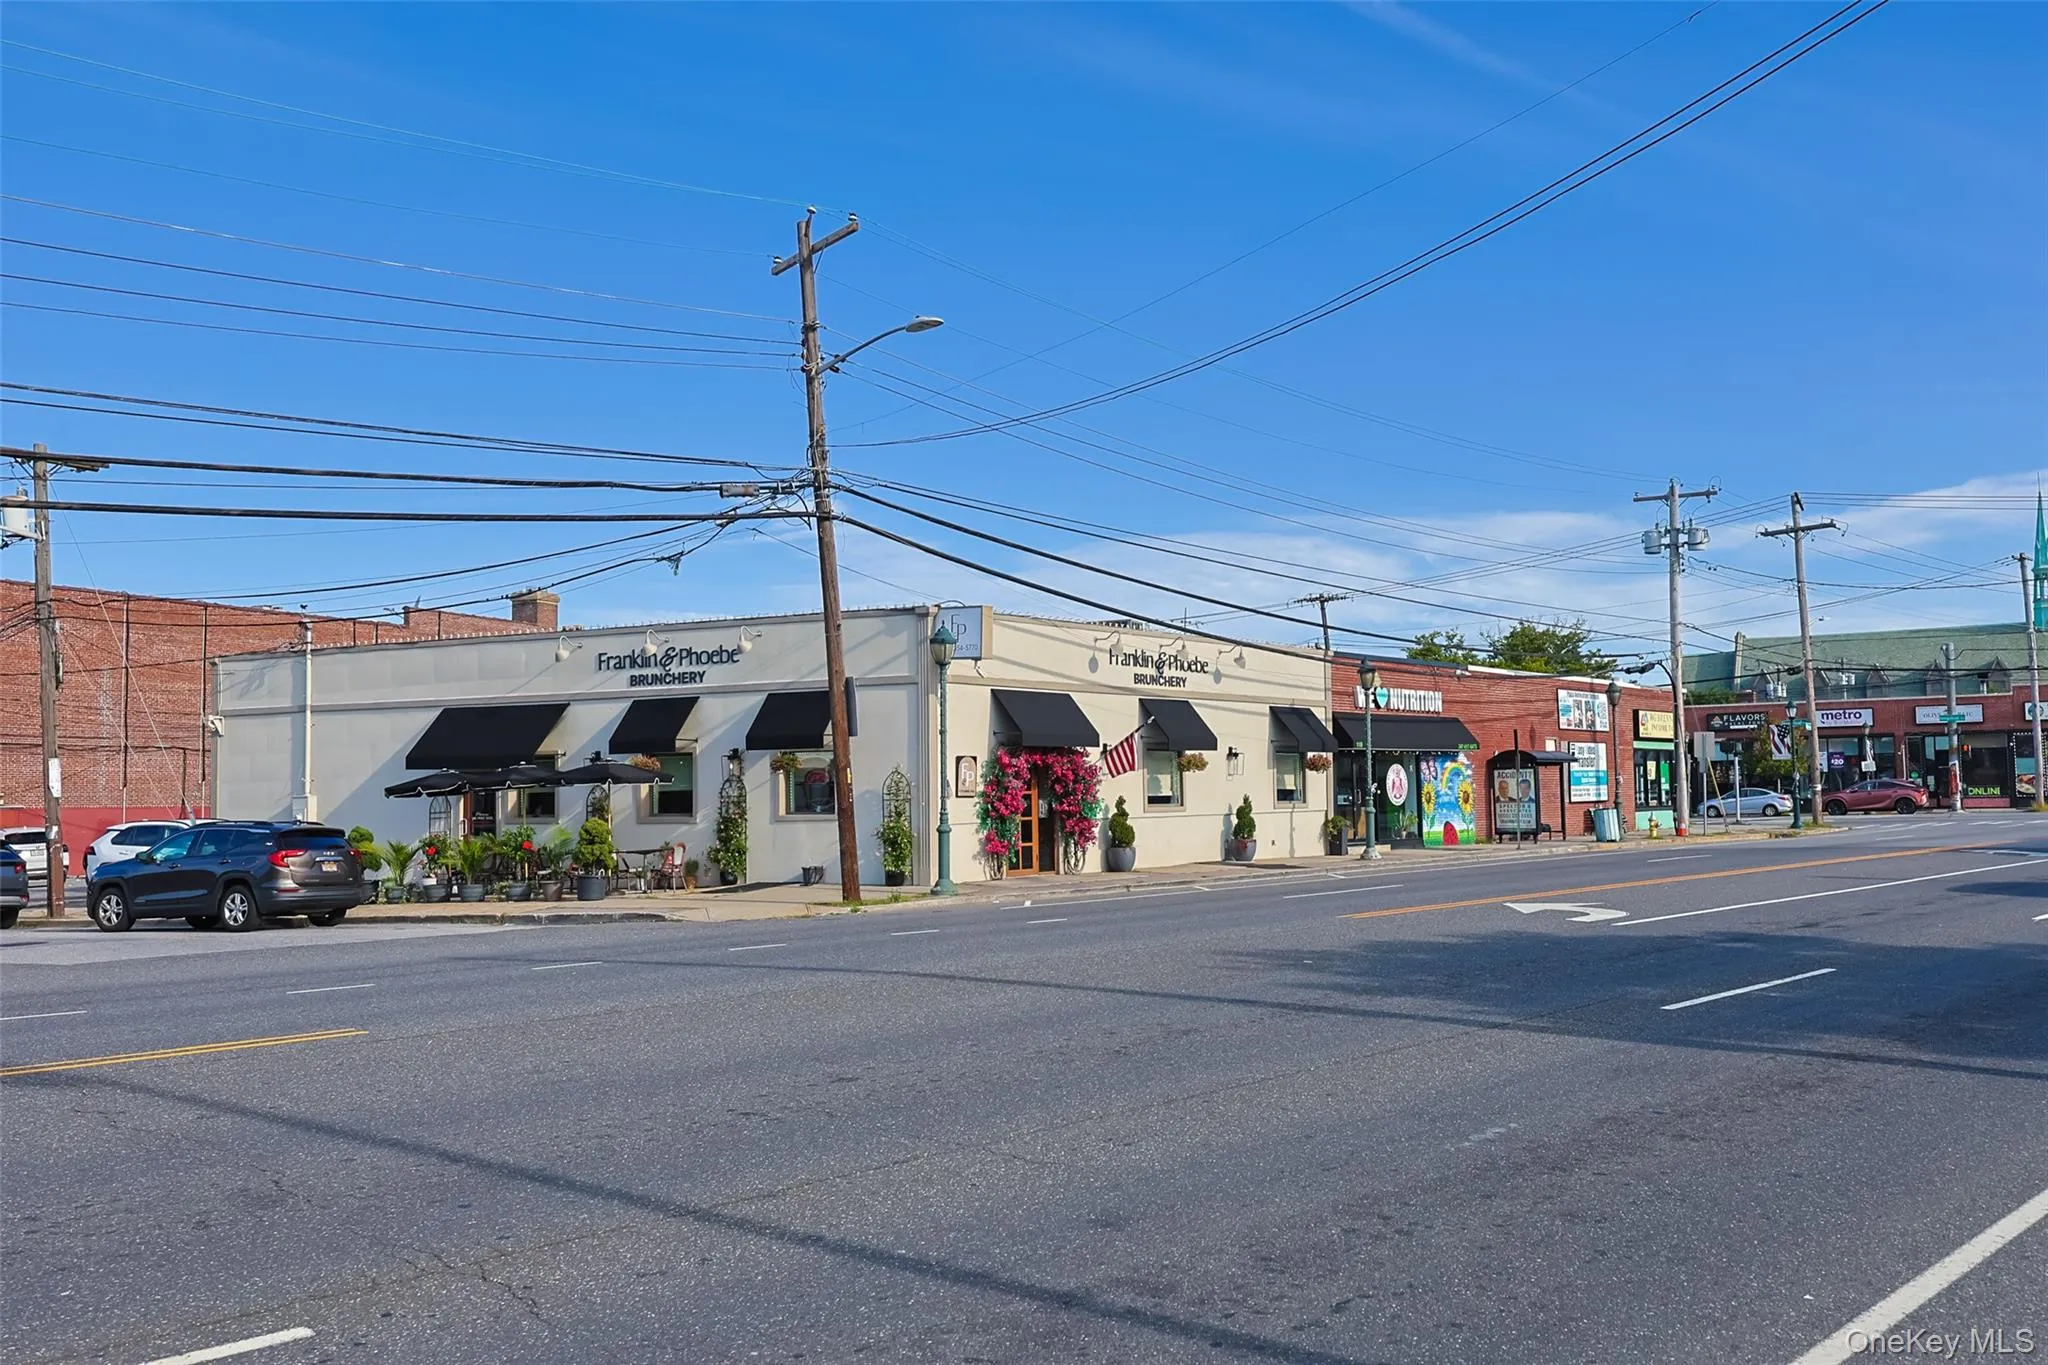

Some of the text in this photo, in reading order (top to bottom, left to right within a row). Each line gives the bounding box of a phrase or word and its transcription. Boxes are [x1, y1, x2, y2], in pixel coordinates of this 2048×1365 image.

[598, 645, 739, 672] Franklin & Phoebe
[1109, 648, 1209, 675] Franklin & Phoebe
[630, 671, 706, 687] BRUNCHERY
[1134, 673, 1187, 688] BRUNCHERY
[1389, 688, 1442, 713] NUTRITION
[1723, 713, 1766, 721] FLAVORS
[1821, 710, 1862, 720] metro
